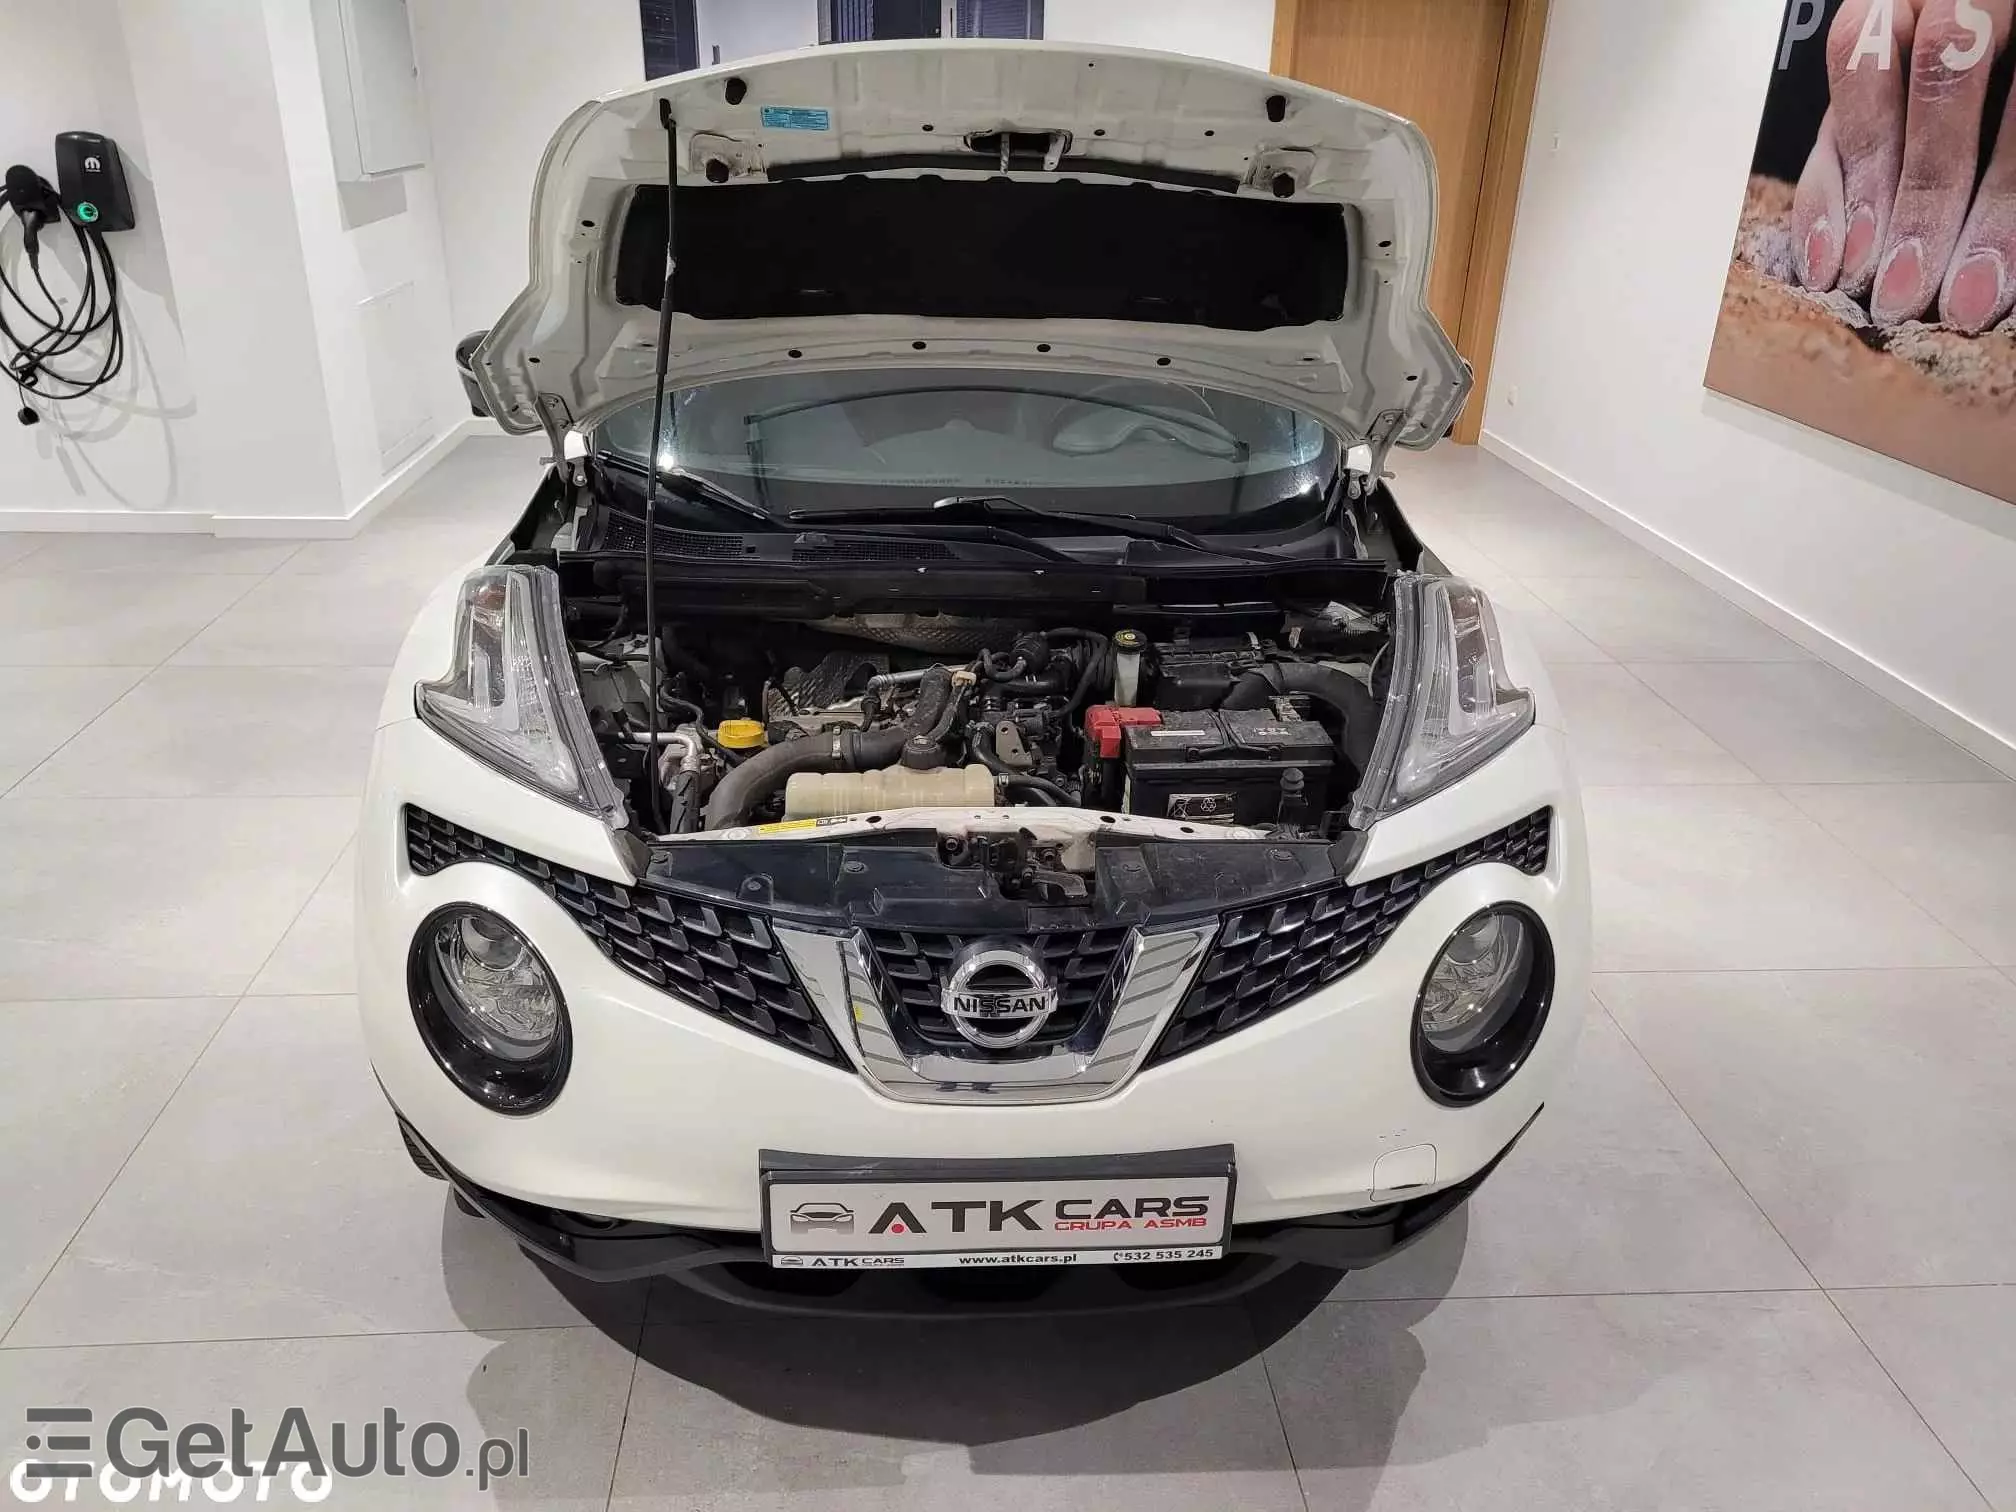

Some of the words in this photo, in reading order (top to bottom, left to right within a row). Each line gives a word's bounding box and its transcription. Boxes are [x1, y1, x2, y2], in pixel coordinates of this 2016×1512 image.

[953, 996, 1046, 1014] NISSAN
[868, 1200, 1044, 1234] ATK
[1055, 1196, 1210, 1220] CARS
[1054, 1220, 1132, 1231] GRUPA
[1144, 1218, 1207, 1228] ASMB
[959, 1253, 1077, 1264] www.atkcars.pl
[1124, 1252, 1151, 1260] 532
[1155, 1251, 1182, 1259] 535
[1186, 1249, 1213, 1258] 245
[811, 1257, 858, 1267] ATK
